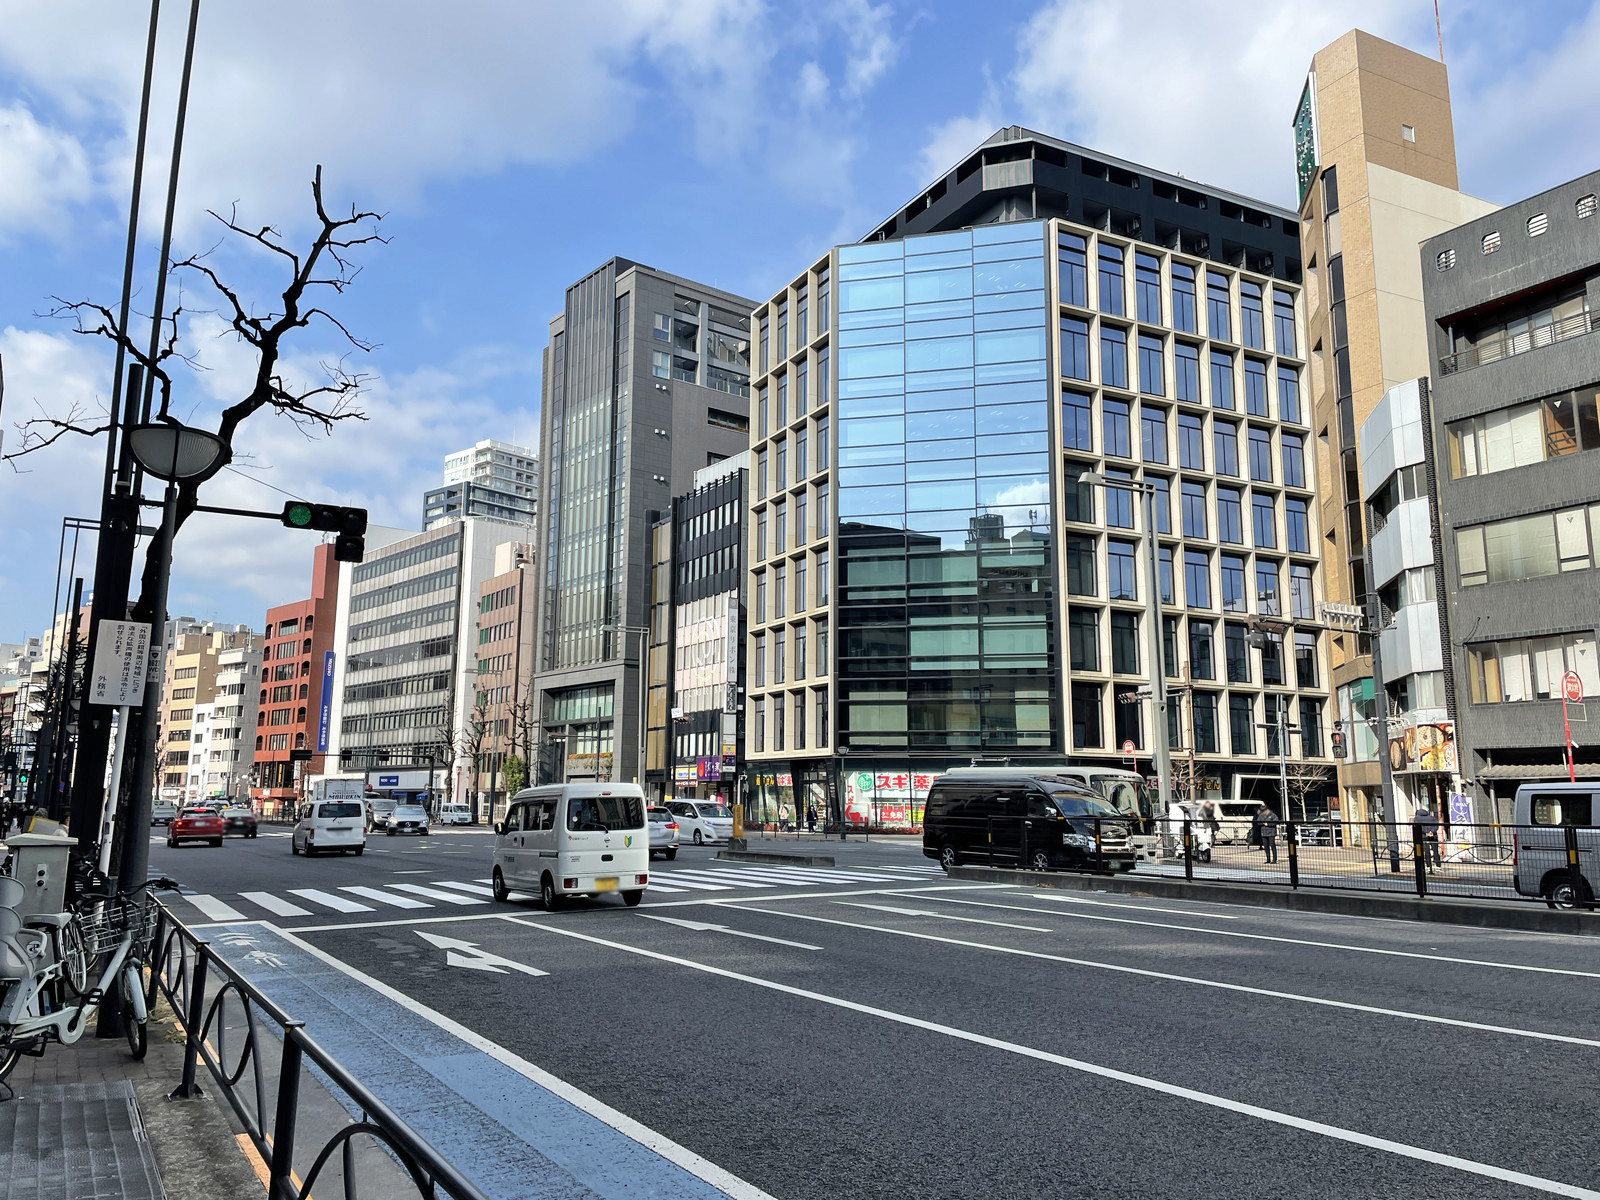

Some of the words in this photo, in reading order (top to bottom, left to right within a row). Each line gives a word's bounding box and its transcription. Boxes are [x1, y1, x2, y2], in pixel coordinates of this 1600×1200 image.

[97, 675, 107, 697] 外務省
[875, 773, 939, 789] スギ薬
